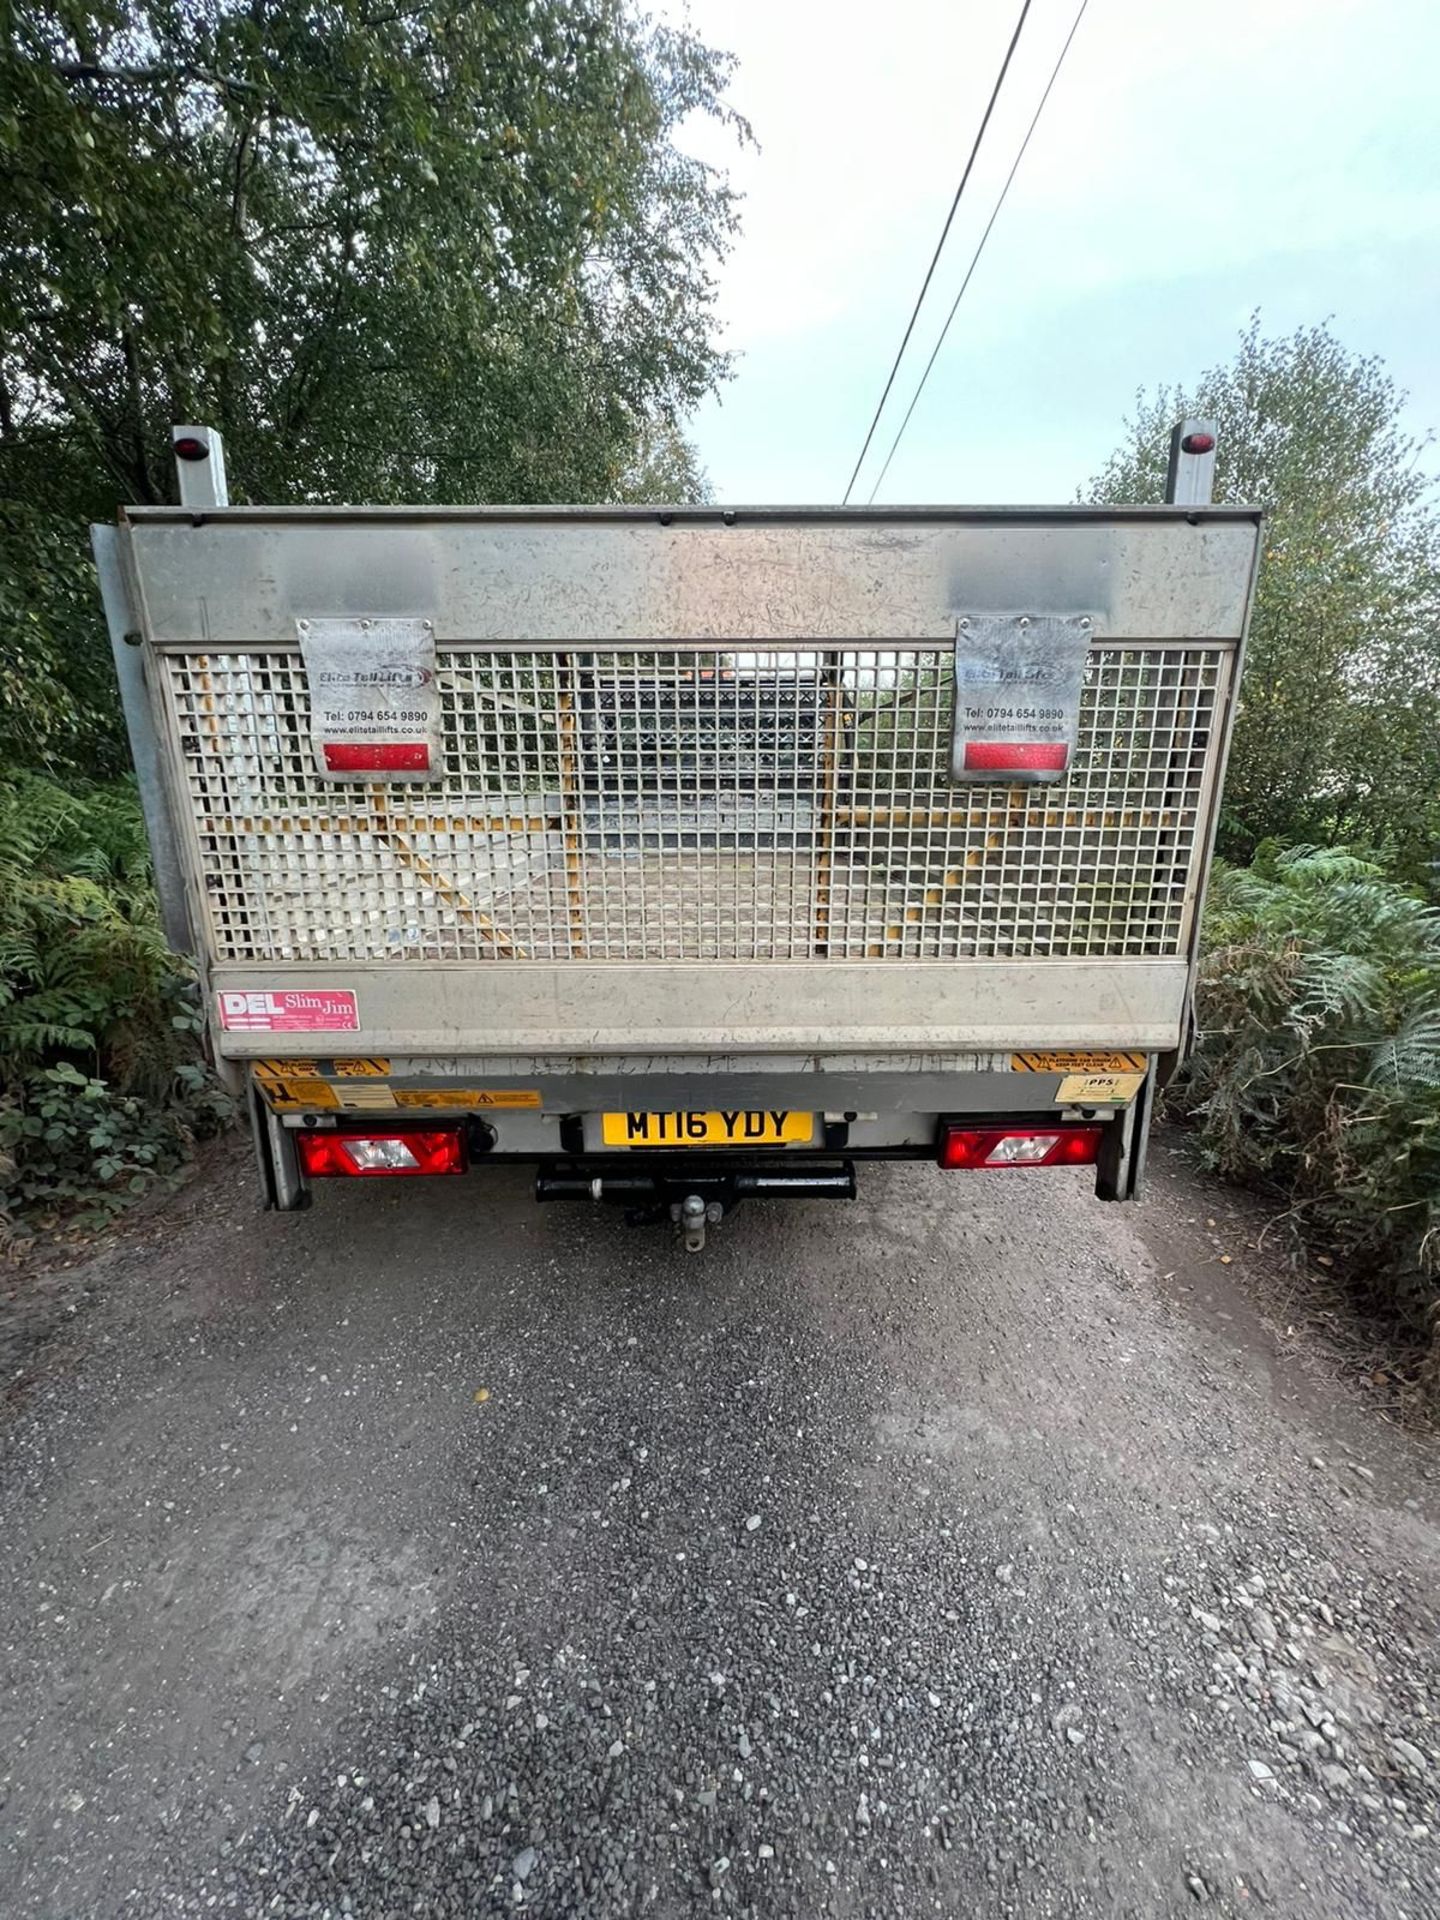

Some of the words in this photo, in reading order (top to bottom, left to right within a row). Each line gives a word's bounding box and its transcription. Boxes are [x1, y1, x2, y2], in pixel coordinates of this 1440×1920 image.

[323, 711, 344, 721] Tel:
[347, 711, 374, 721] 0794
[377, 711, 398, 721] 654
[400, 711, 428, 722] 9890
[965, 707, 984, 718] Tel:
[986, 708, 1013, 719] 0794
[1016, 708, 1036, 719] 654
[1039, 709, 1064, 720] 9890
[223, 994, 286, 1015] DEL
[285, 993, 322, 1009] Slim
[322, 1000, 353, 1015] Jim
[627, 1111, 708, 1139] MT16
[721, 1111, 788, 1138] YDY
